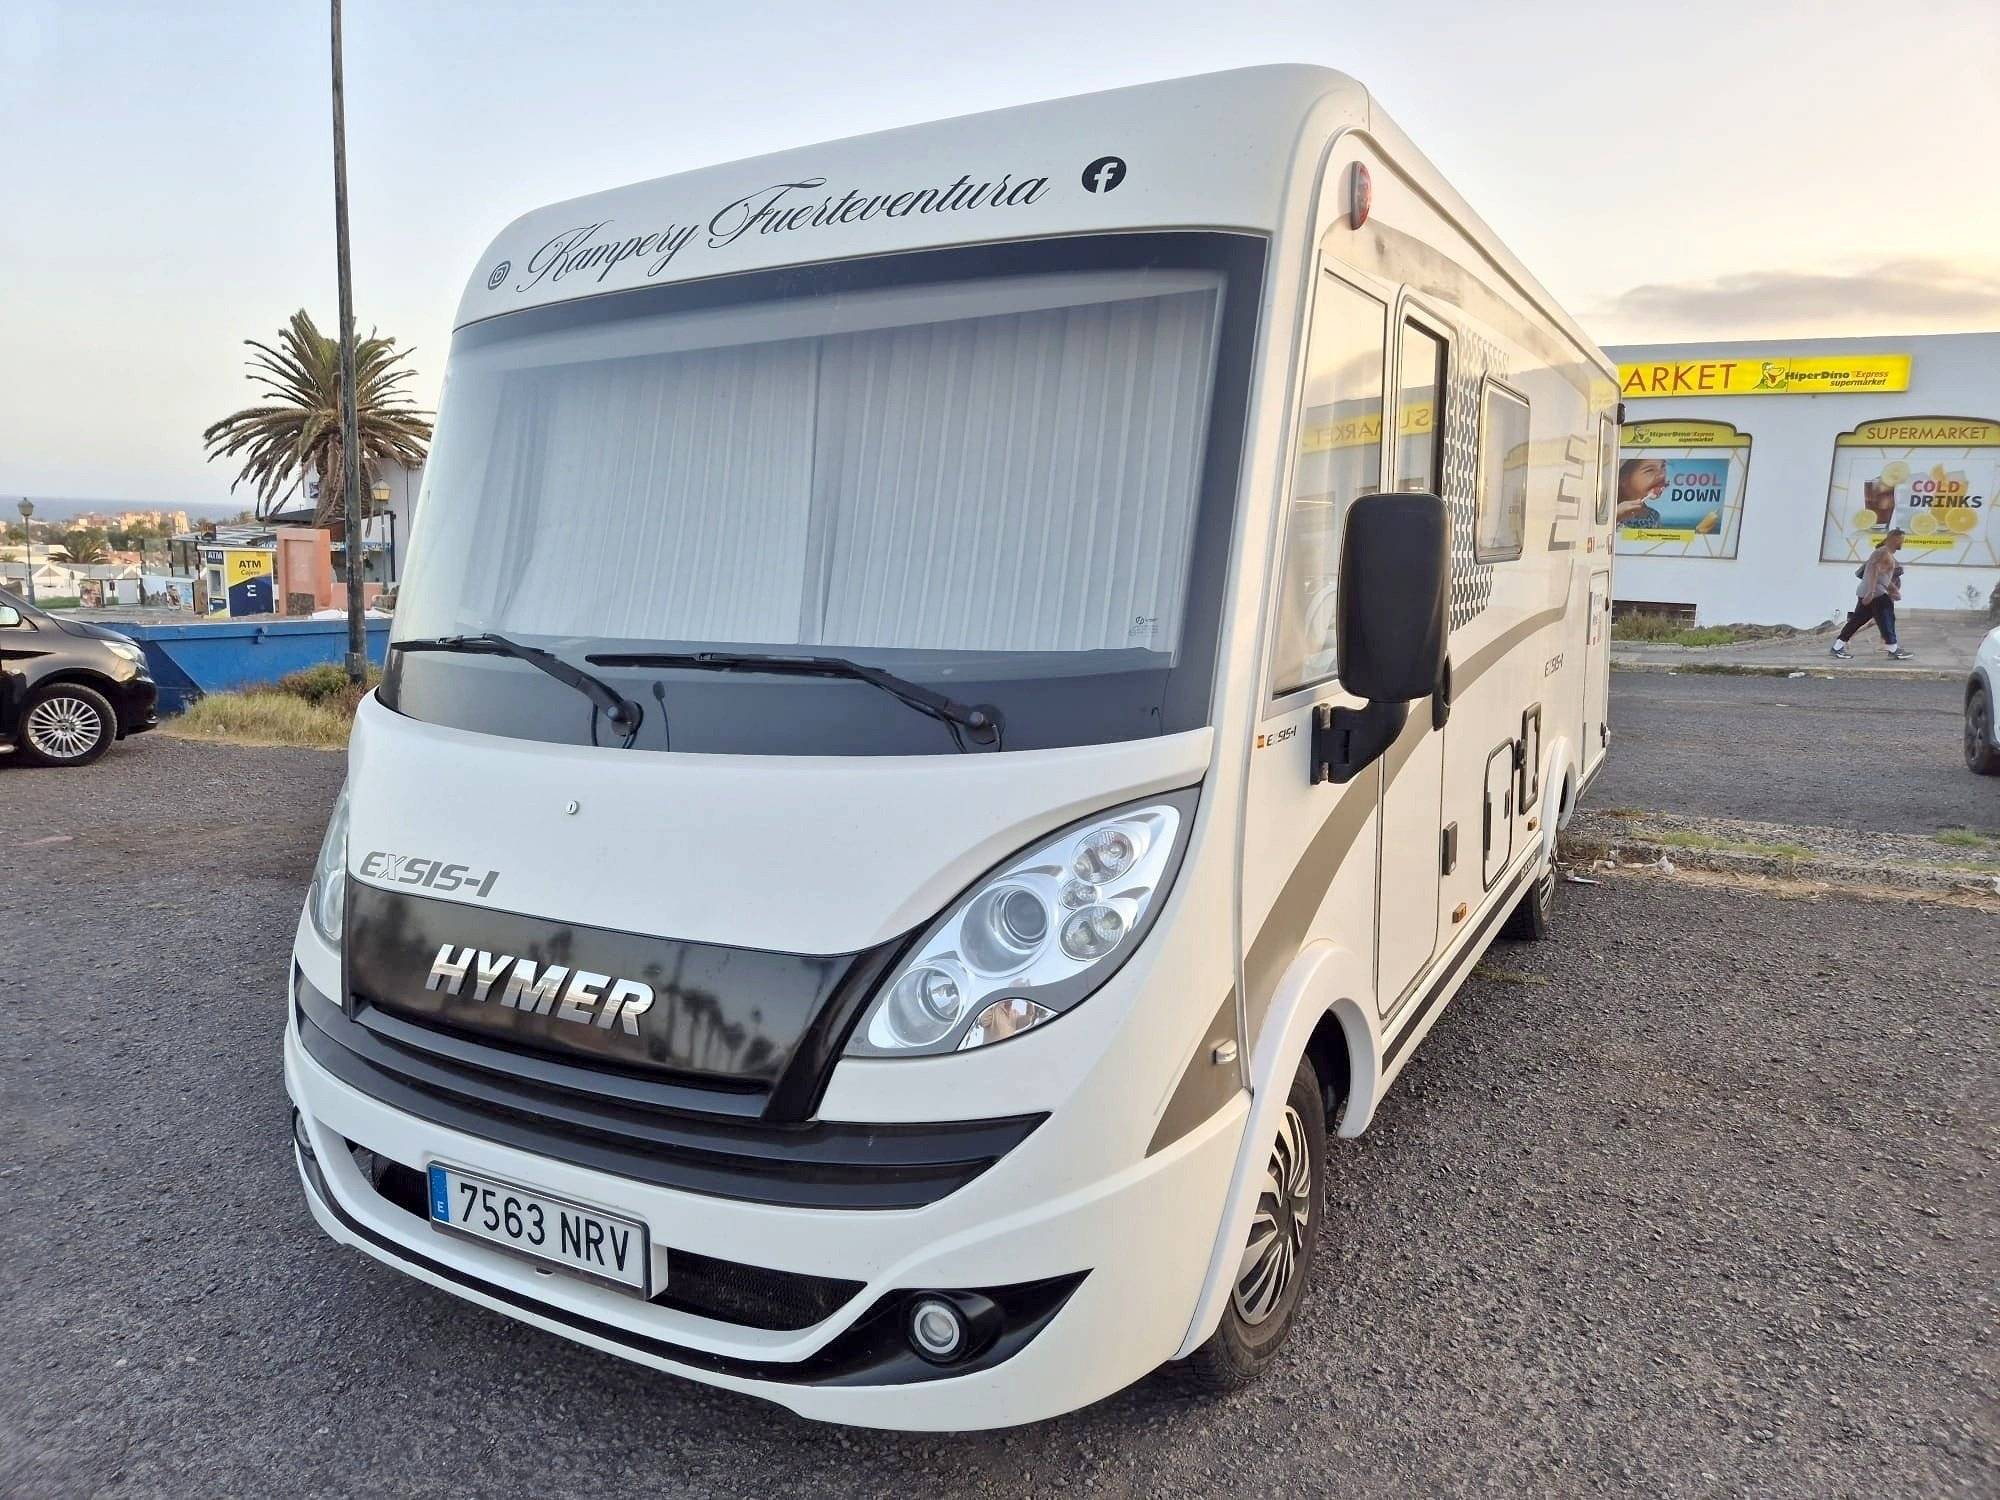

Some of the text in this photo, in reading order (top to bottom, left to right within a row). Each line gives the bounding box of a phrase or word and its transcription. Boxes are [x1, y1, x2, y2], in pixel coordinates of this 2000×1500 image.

[516, 174, 1050, 293] Kampery Fuerteventura
[1622, 363, 1738, 393] ARKET
[1785, 370, 1850, 381] HiperDino
[1830, 378, 1886, 387] supermarket
[1867, 427, 1990, 440] SUPERMARKET
[1673, 473, 1722, 487] COOL
[1911, 480, 1961, 493] COLD
[1671, 488, 1721, 502] DOWN
[1909, 495, 1983, 508] DRINKS
[208, 551, 223, 560] ATM
[239, 560, 262, 568] ATM
[1267, 725, 1297, 746] ESIS-I
[360, 851, 500, 897] EXSIS-I
[425, 944, 655, 1036] HYMER
[460, 1182, 630, 1272] 7563 NRV
